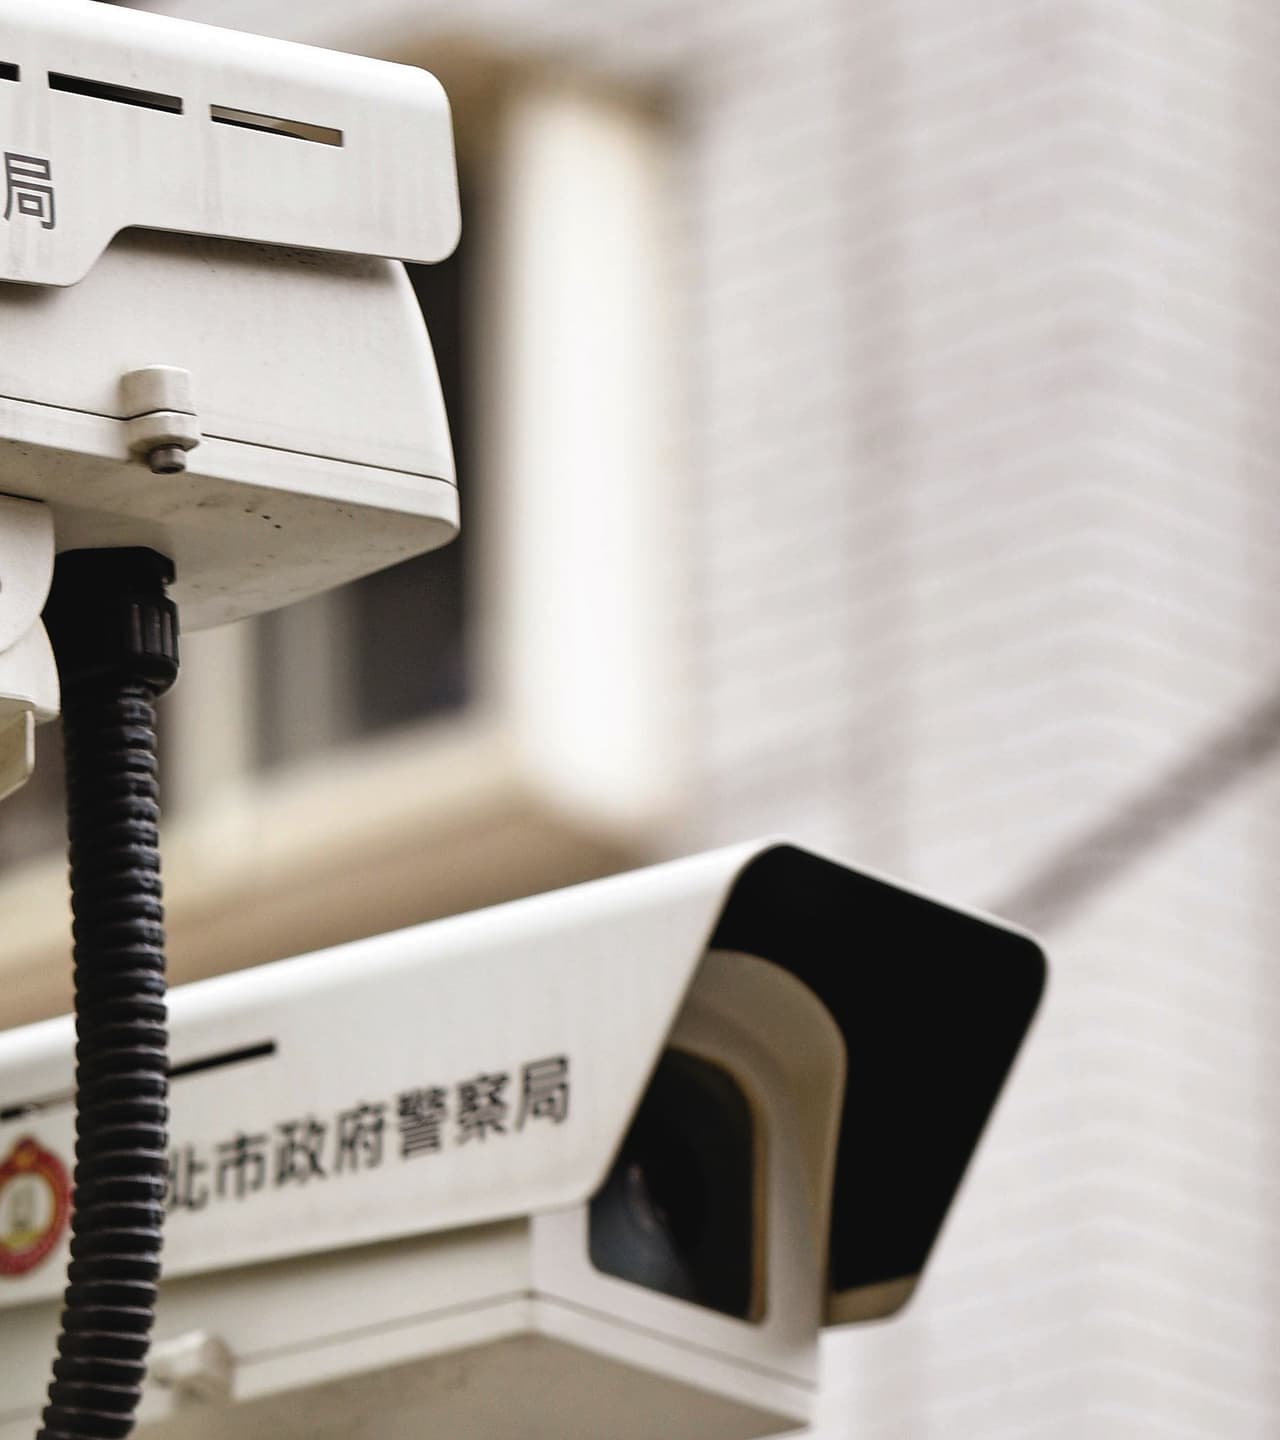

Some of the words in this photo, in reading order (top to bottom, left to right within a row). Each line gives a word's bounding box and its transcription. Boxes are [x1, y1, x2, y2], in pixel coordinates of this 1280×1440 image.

[167, 1054, 570, 1214] 北市政府警察局
